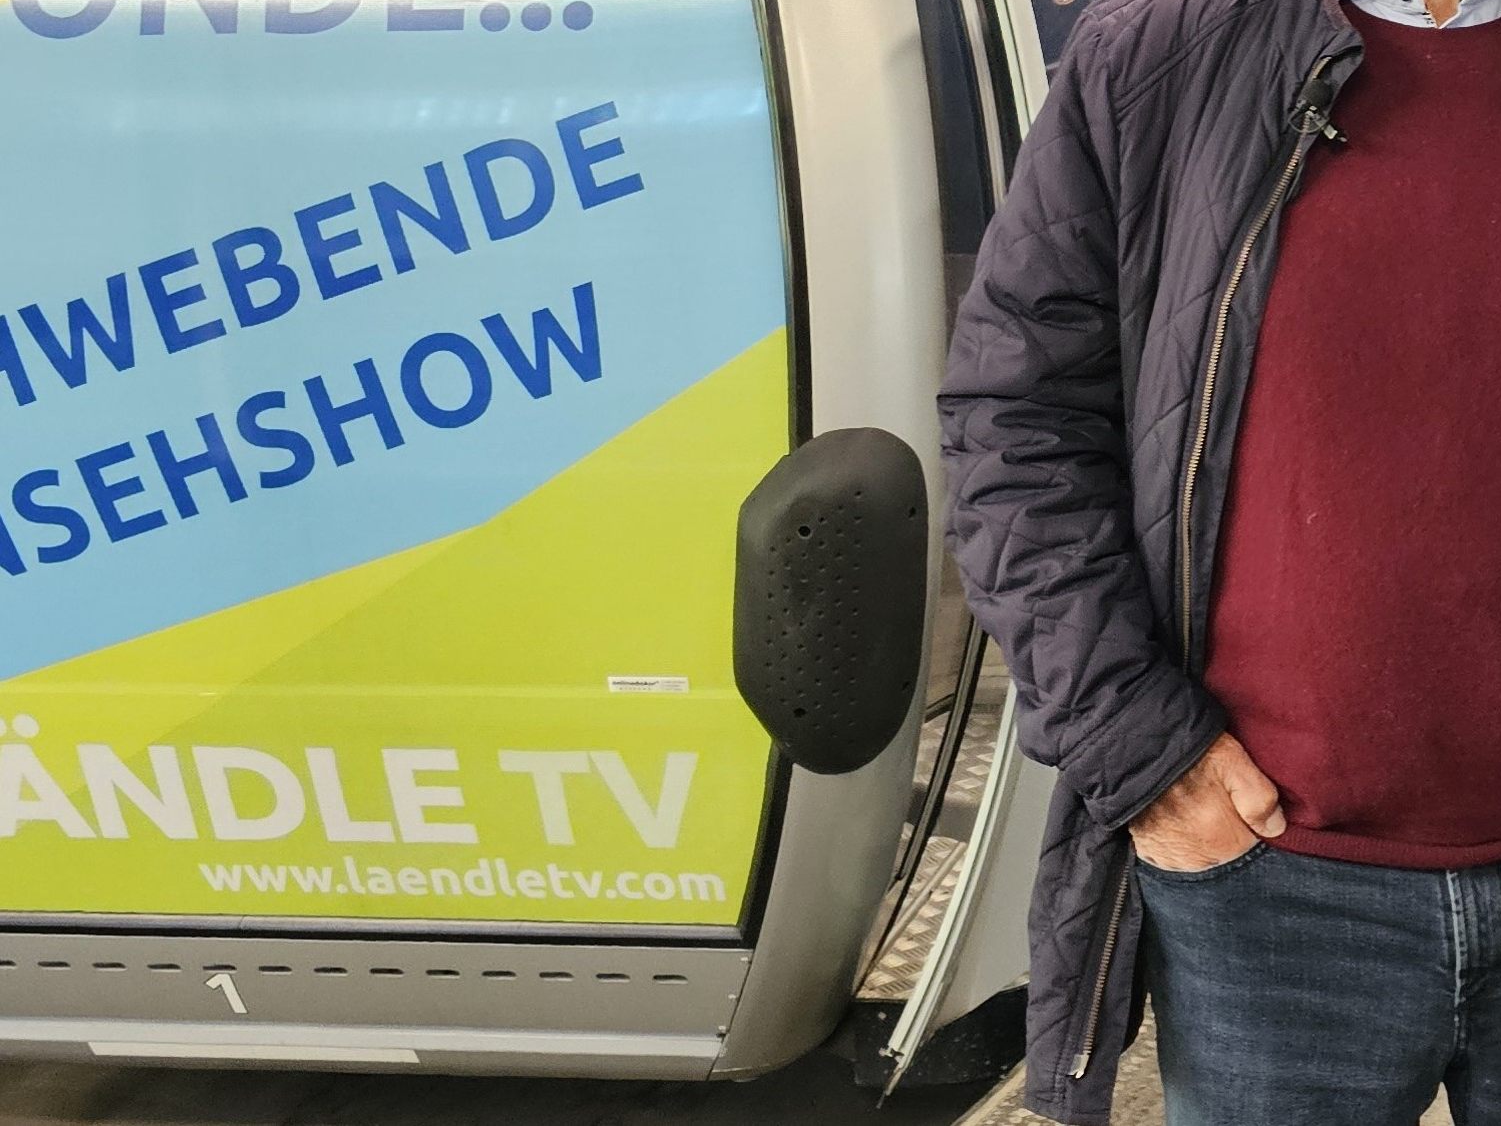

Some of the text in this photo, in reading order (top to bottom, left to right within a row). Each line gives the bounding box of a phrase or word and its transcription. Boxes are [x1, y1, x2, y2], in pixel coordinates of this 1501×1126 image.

[499, 750, 698, 848] TV
[200, 856, 726, 901] www.laendletv.com
[205, 973, 248, 1014] 1
